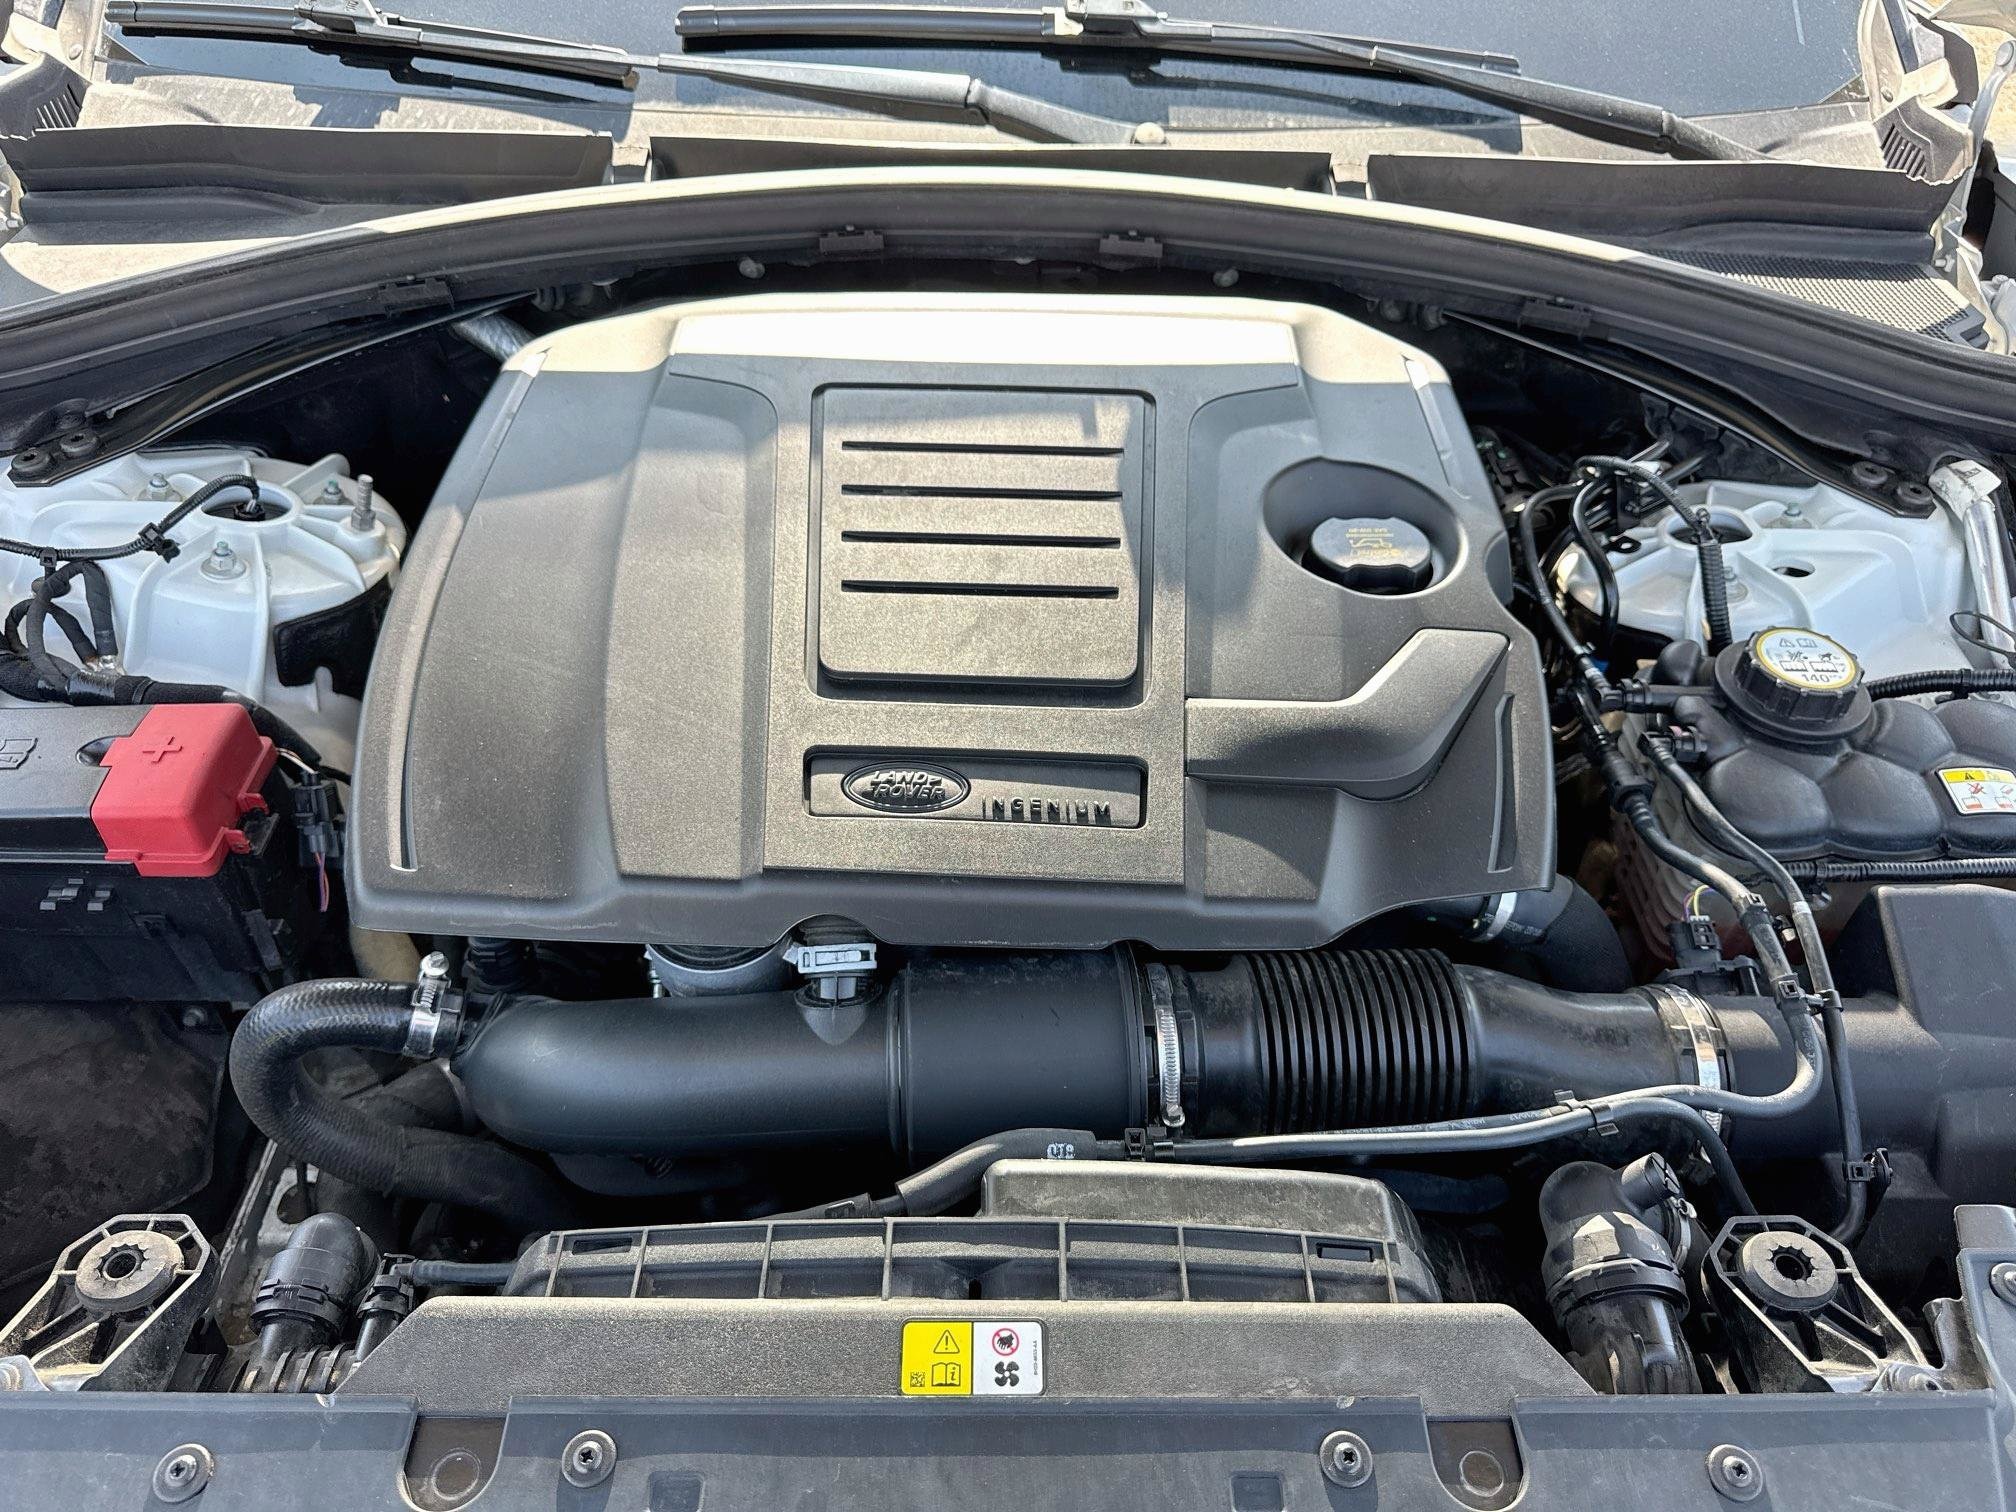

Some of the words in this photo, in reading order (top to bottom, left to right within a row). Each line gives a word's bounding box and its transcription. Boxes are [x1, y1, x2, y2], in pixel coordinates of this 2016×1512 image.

[1802, 674, 1830, 683] 140
[871, 770, 928, 784] LAND
[873, 783, 946, 799] ROVER
[981, 795, 1111, 820] INGENIUM
